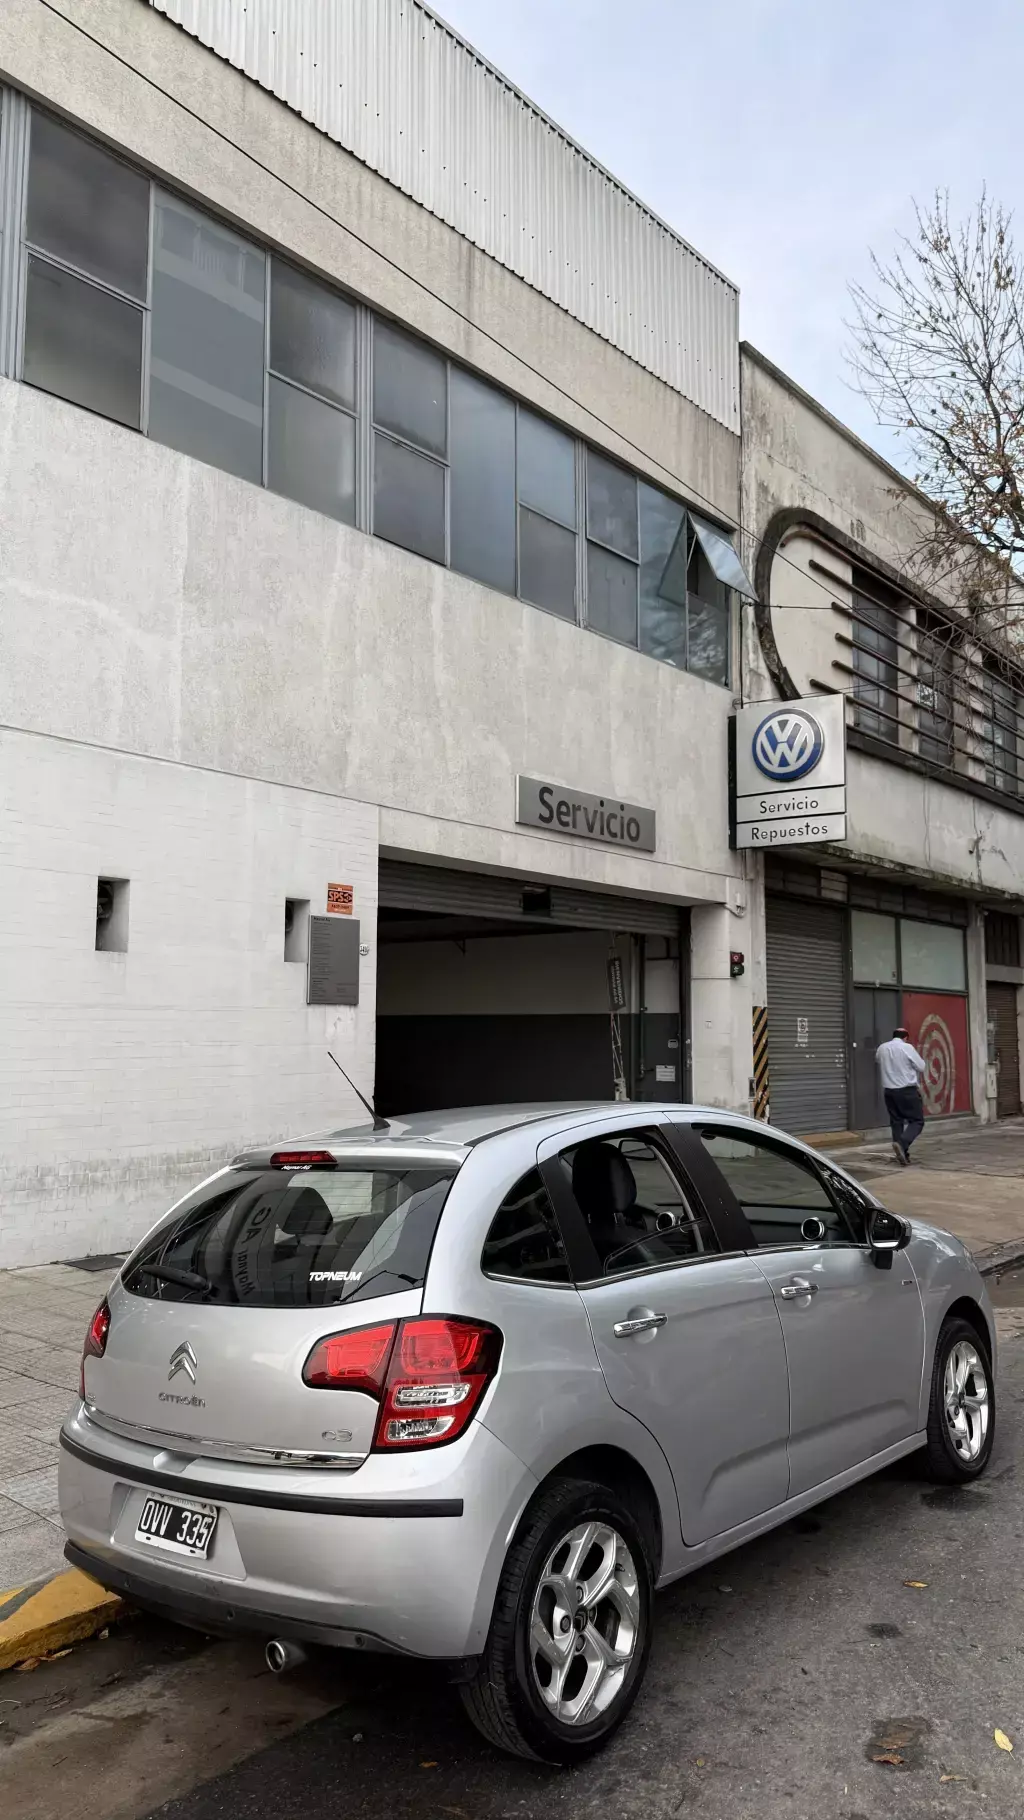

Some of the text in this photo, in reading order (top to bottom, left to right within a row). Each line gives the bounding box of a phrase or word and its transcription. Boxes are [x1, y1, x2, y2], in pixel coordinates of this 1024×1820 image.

[538, 786, 641, 843] Servicio
[759, 796, 819, 814] Servicio
[751, 822, 828, 842] Repuestos
[309, 1271, 362, 1281] TOPNEUM
[321, 1429, 353, 1442] C3
[140, 1501, 213, 1548] OVV 335
